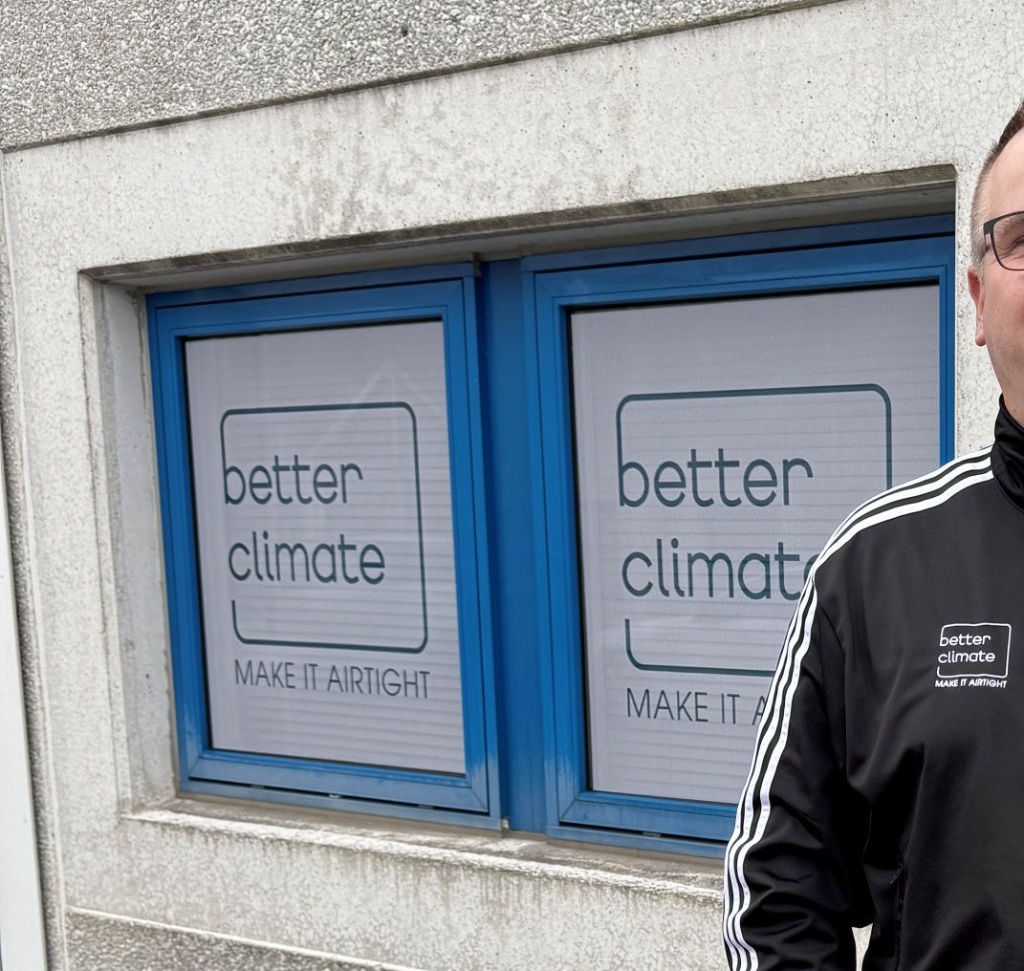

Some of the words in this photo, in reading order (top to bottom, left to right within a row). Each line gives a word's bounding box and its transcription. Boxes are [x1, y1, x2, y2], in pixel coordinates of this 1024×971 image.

[223, 455, 363, 505] better
[618, 448, 814, 507] better
[228, 531, 385, 585] climate
[938, 650, 996, 663] climate
[940, 633, 991, 647] better
[234, 659, 296, 689] MAKE
[304, 663, 318, 691] IT
[327, 665, 430, 699] AIRTIGHT
[935, 679, 958, 687] MAKE
[960, 679, 967, 687] IT
[968, 679, 1007, 688] AIRTIGHT
[626, 687, 709, 723] MAKE
[721, 693, 740, 725] IT
